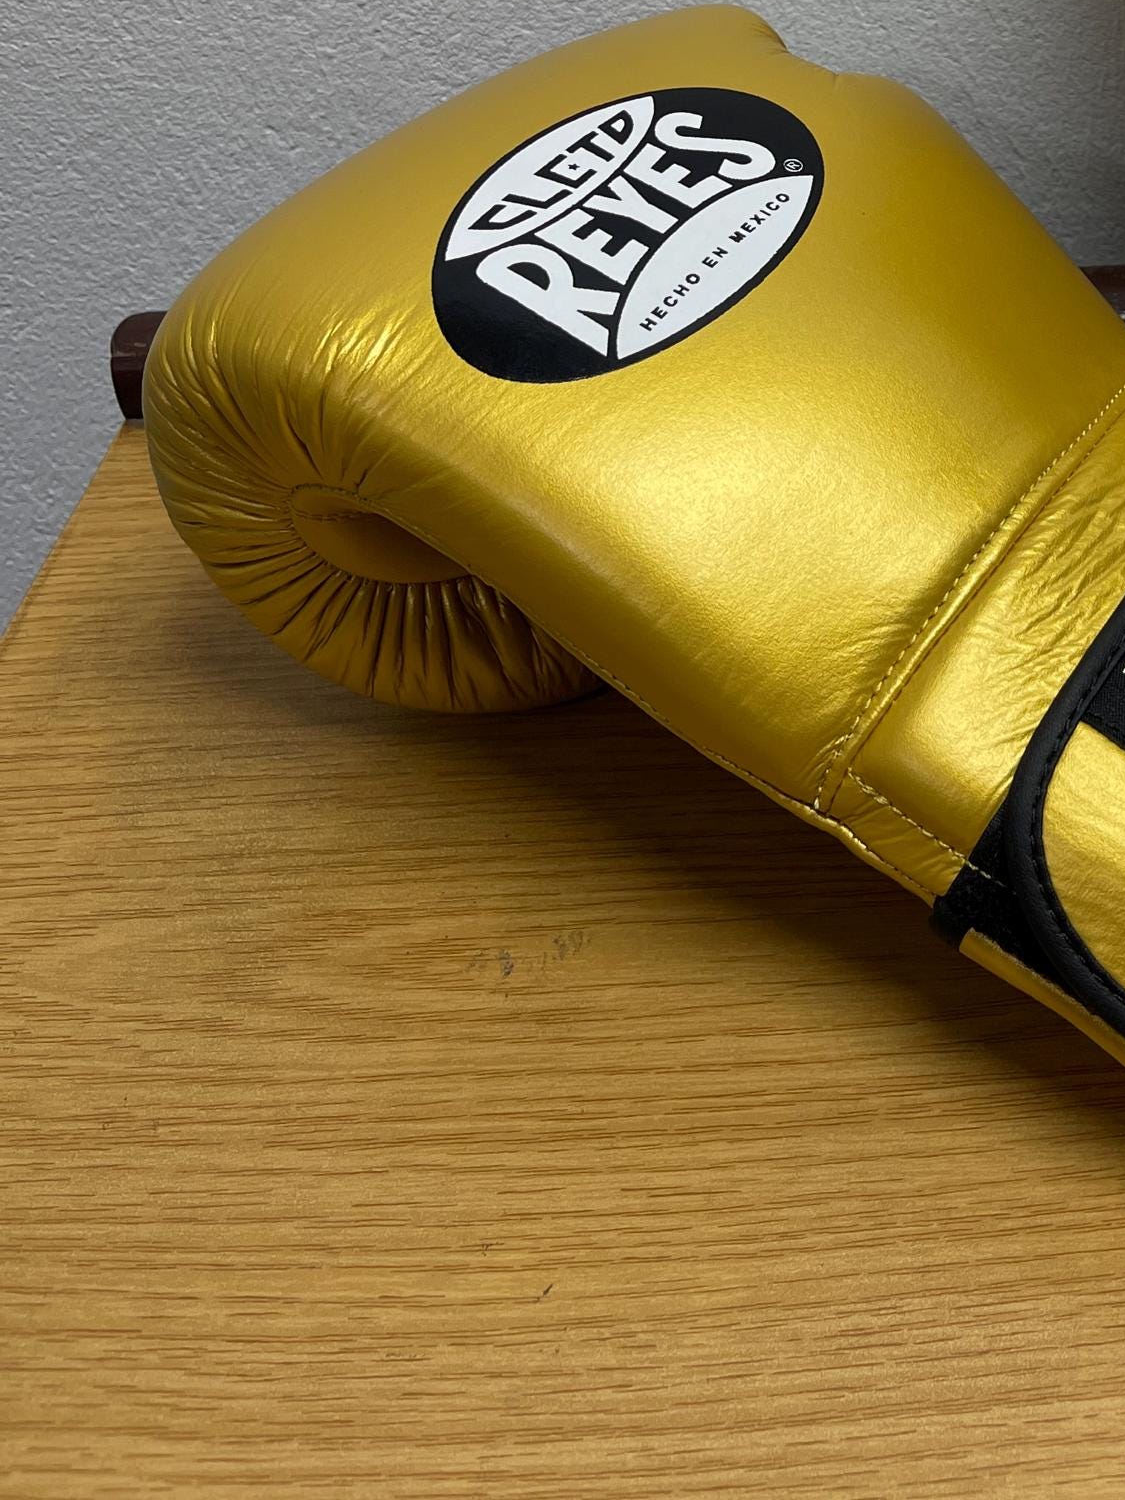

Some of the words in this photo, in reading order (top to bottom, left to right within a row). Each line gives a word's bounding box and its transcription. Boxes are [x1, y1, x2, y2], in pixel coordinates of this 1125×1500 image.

[476, 111, 776, 357] REYES
[639, 272, 700, 332] HECHO
[702, 246, 729, 267] EN
[728, 191, 790, 244] MEXICO
